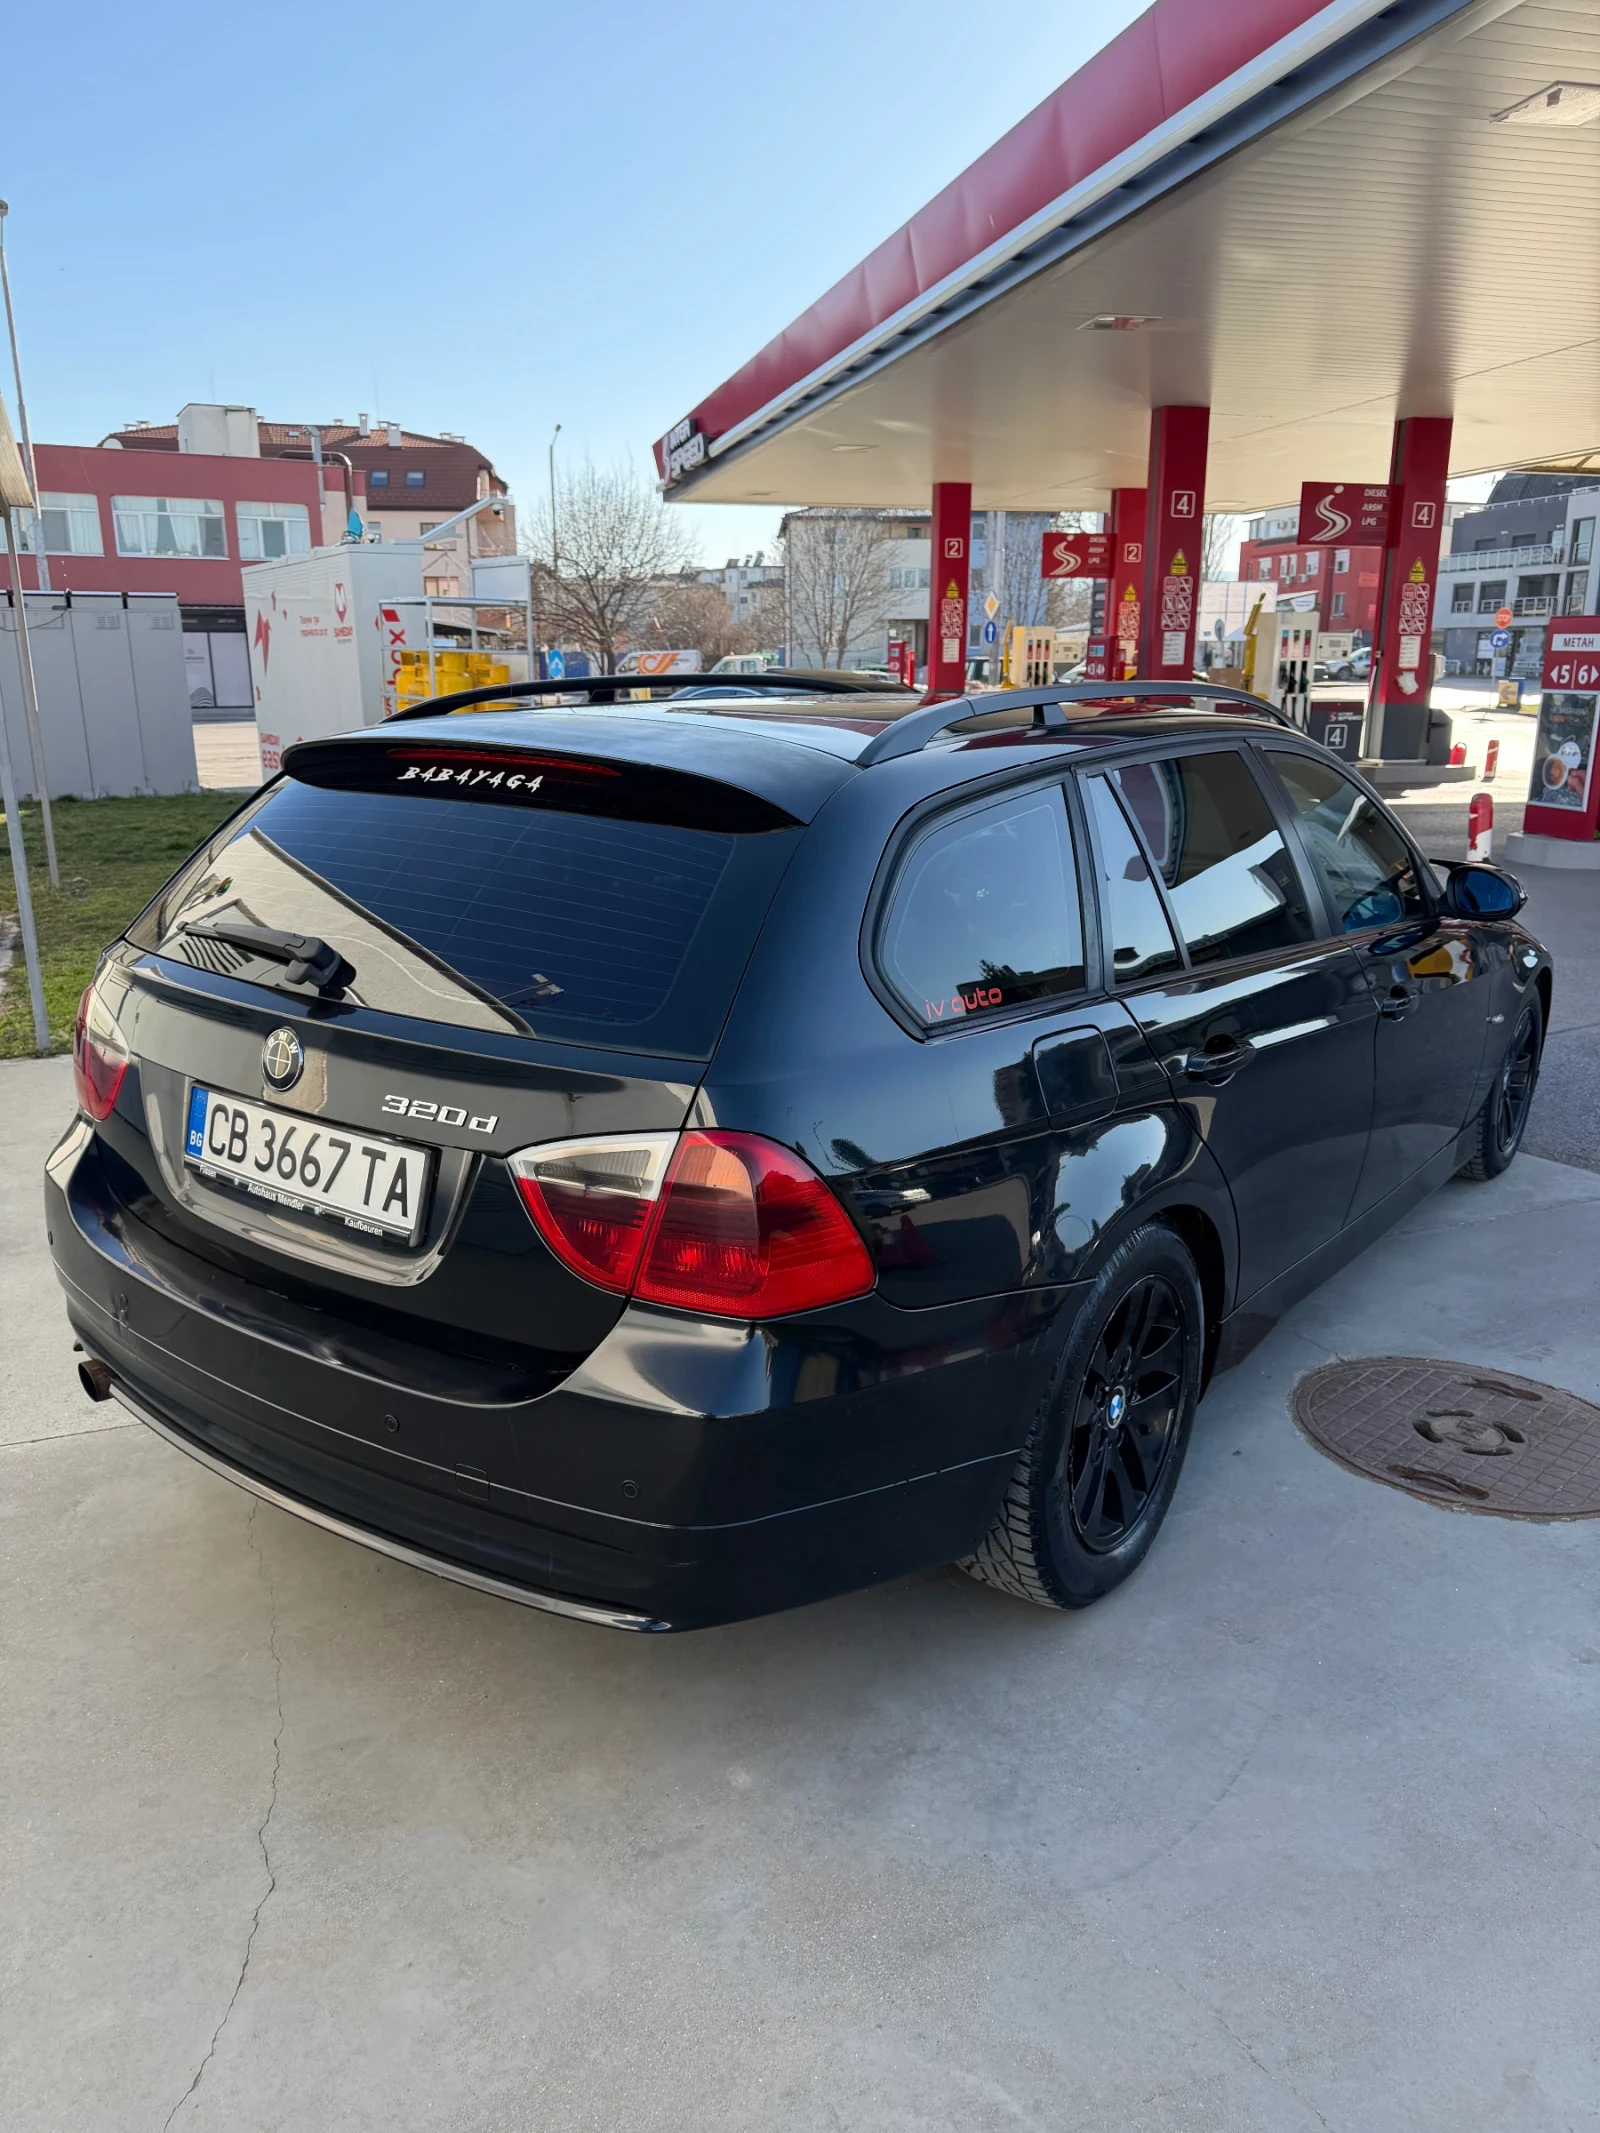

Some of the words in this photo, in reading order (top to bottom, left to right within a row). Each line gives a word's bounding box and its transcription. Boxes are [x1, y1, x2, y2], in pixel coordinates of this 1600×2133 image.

[671, 432, 704, 480] SPEED
[1176, 494, 1190, 514] 4
[1361, 517, 1377, 526] LPG
[1417, 506, 1430, 524] 4
[948, 541, 959, 556] 2
[1127, 546, 1138, 560] 2
[1563, 637, 1595, 648] МЕТАН
[1559, 664, 1571, 684] 5
[1577, 664, 1589, 685] 6
[1329, 728, 1342, 745] 4
[397, 766, 544, 793] BABAYAGA
[951, 987, 1003, 1013] auto
[267, 1030, 299, 1054] BMW
[382, 1094, 499, 1134] 320d
[189, 1130, 203, 1147] BG
[208, 1103, 250, 1164] CB
[254, 1118, 351, 1194] 3667
[361, 1145, 409, 1218] TA
[247, 1183, 277, 1202] Autohaus
[278, 1193, 305, 1211] Mendler
[344, 1216, 383, 1237] Kaufbeuren
